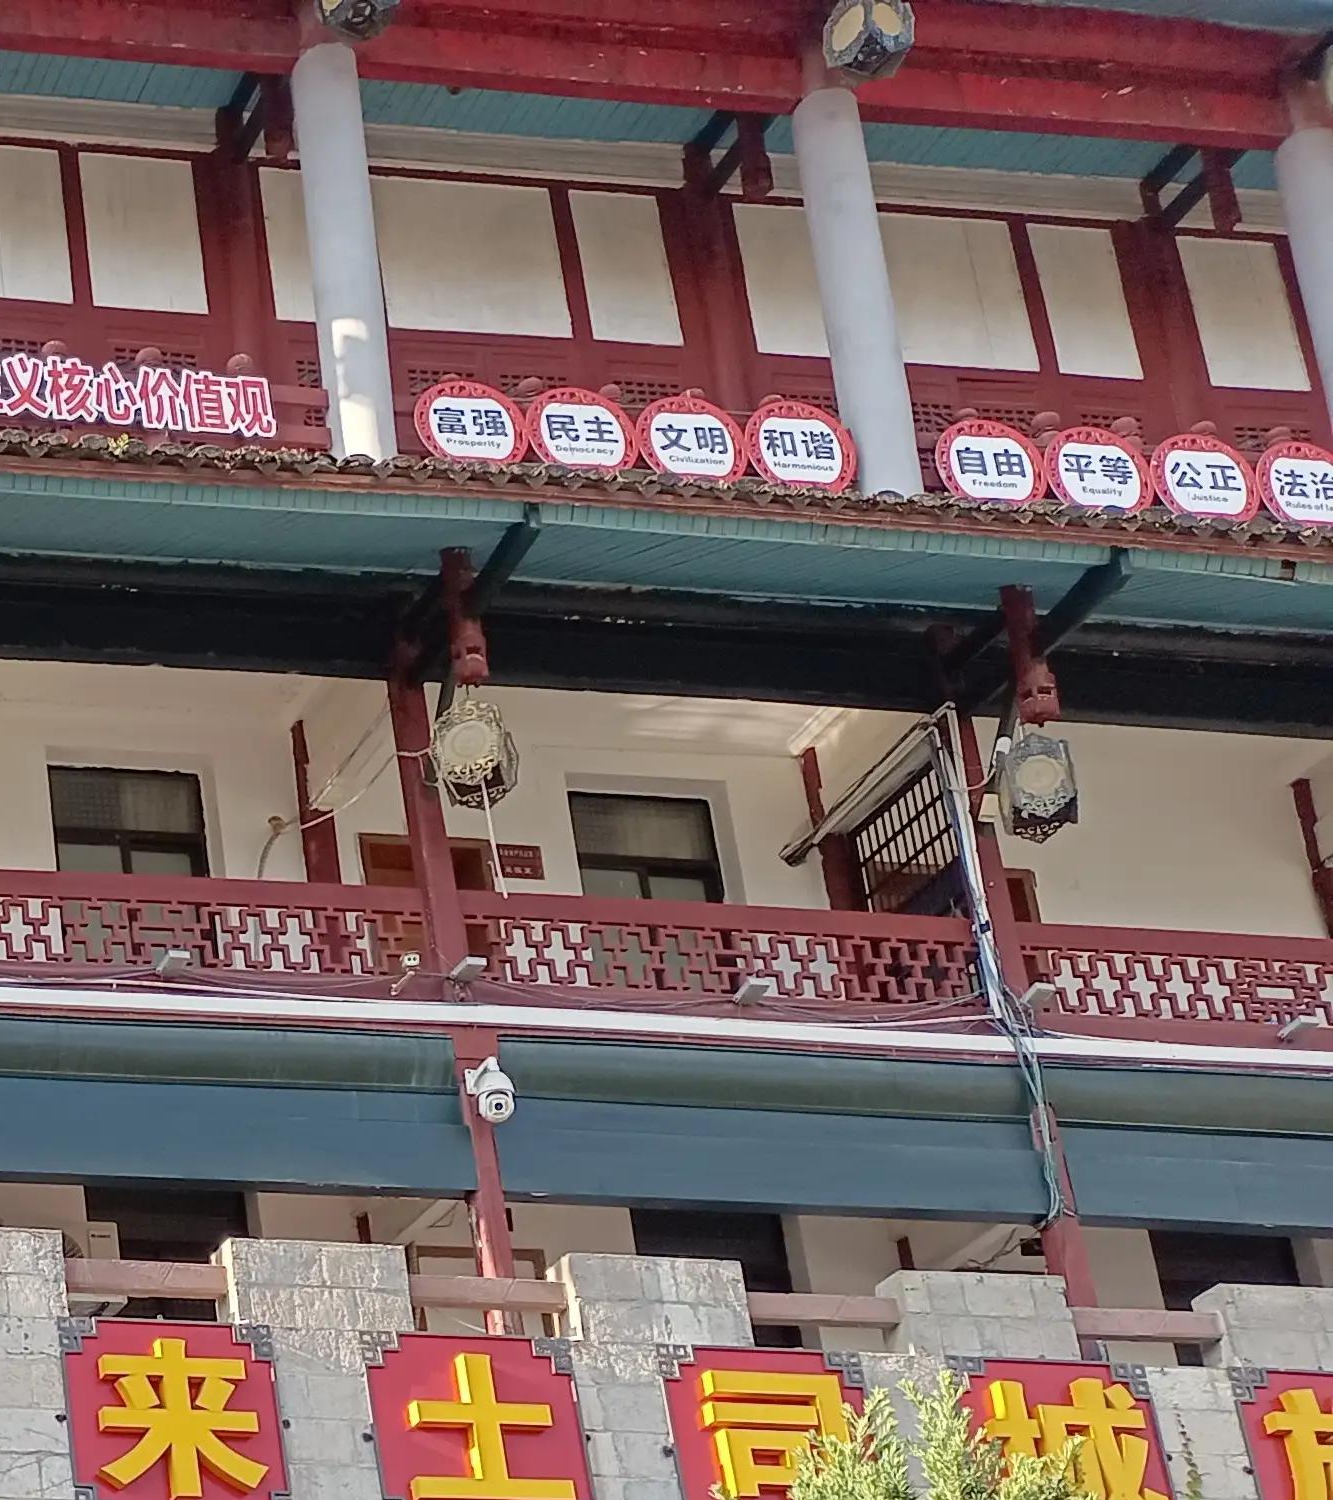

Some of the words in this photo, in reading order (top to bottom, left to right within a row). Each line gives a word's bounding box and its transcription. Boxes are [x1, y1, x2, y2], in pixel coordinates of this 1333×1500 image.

[433, 407, 508, 438] 富强
[546, 414, 619, 444] 民主
[446, 437, 501, 449] Prosperity
[555, 445, 615, 456] Democracy
[655, 424, 729, 454] 文明
[763, 429, 835, 460] 和谐
[669, 455, 725, 465] Civilization
[773, 461, 834, 472] Harmonious
[956, 447, 1026, 478] 自由
[1062, 453, 1133, 485] 平等
[972, 479, 1018, 489] Freedom
[1170, 461, 1241, 491] 公正
[1274, 469, 1333, 500] 法治
[1082, 486, 1123, 497] Equality
[1191, 493, 1229, 503] Justice
